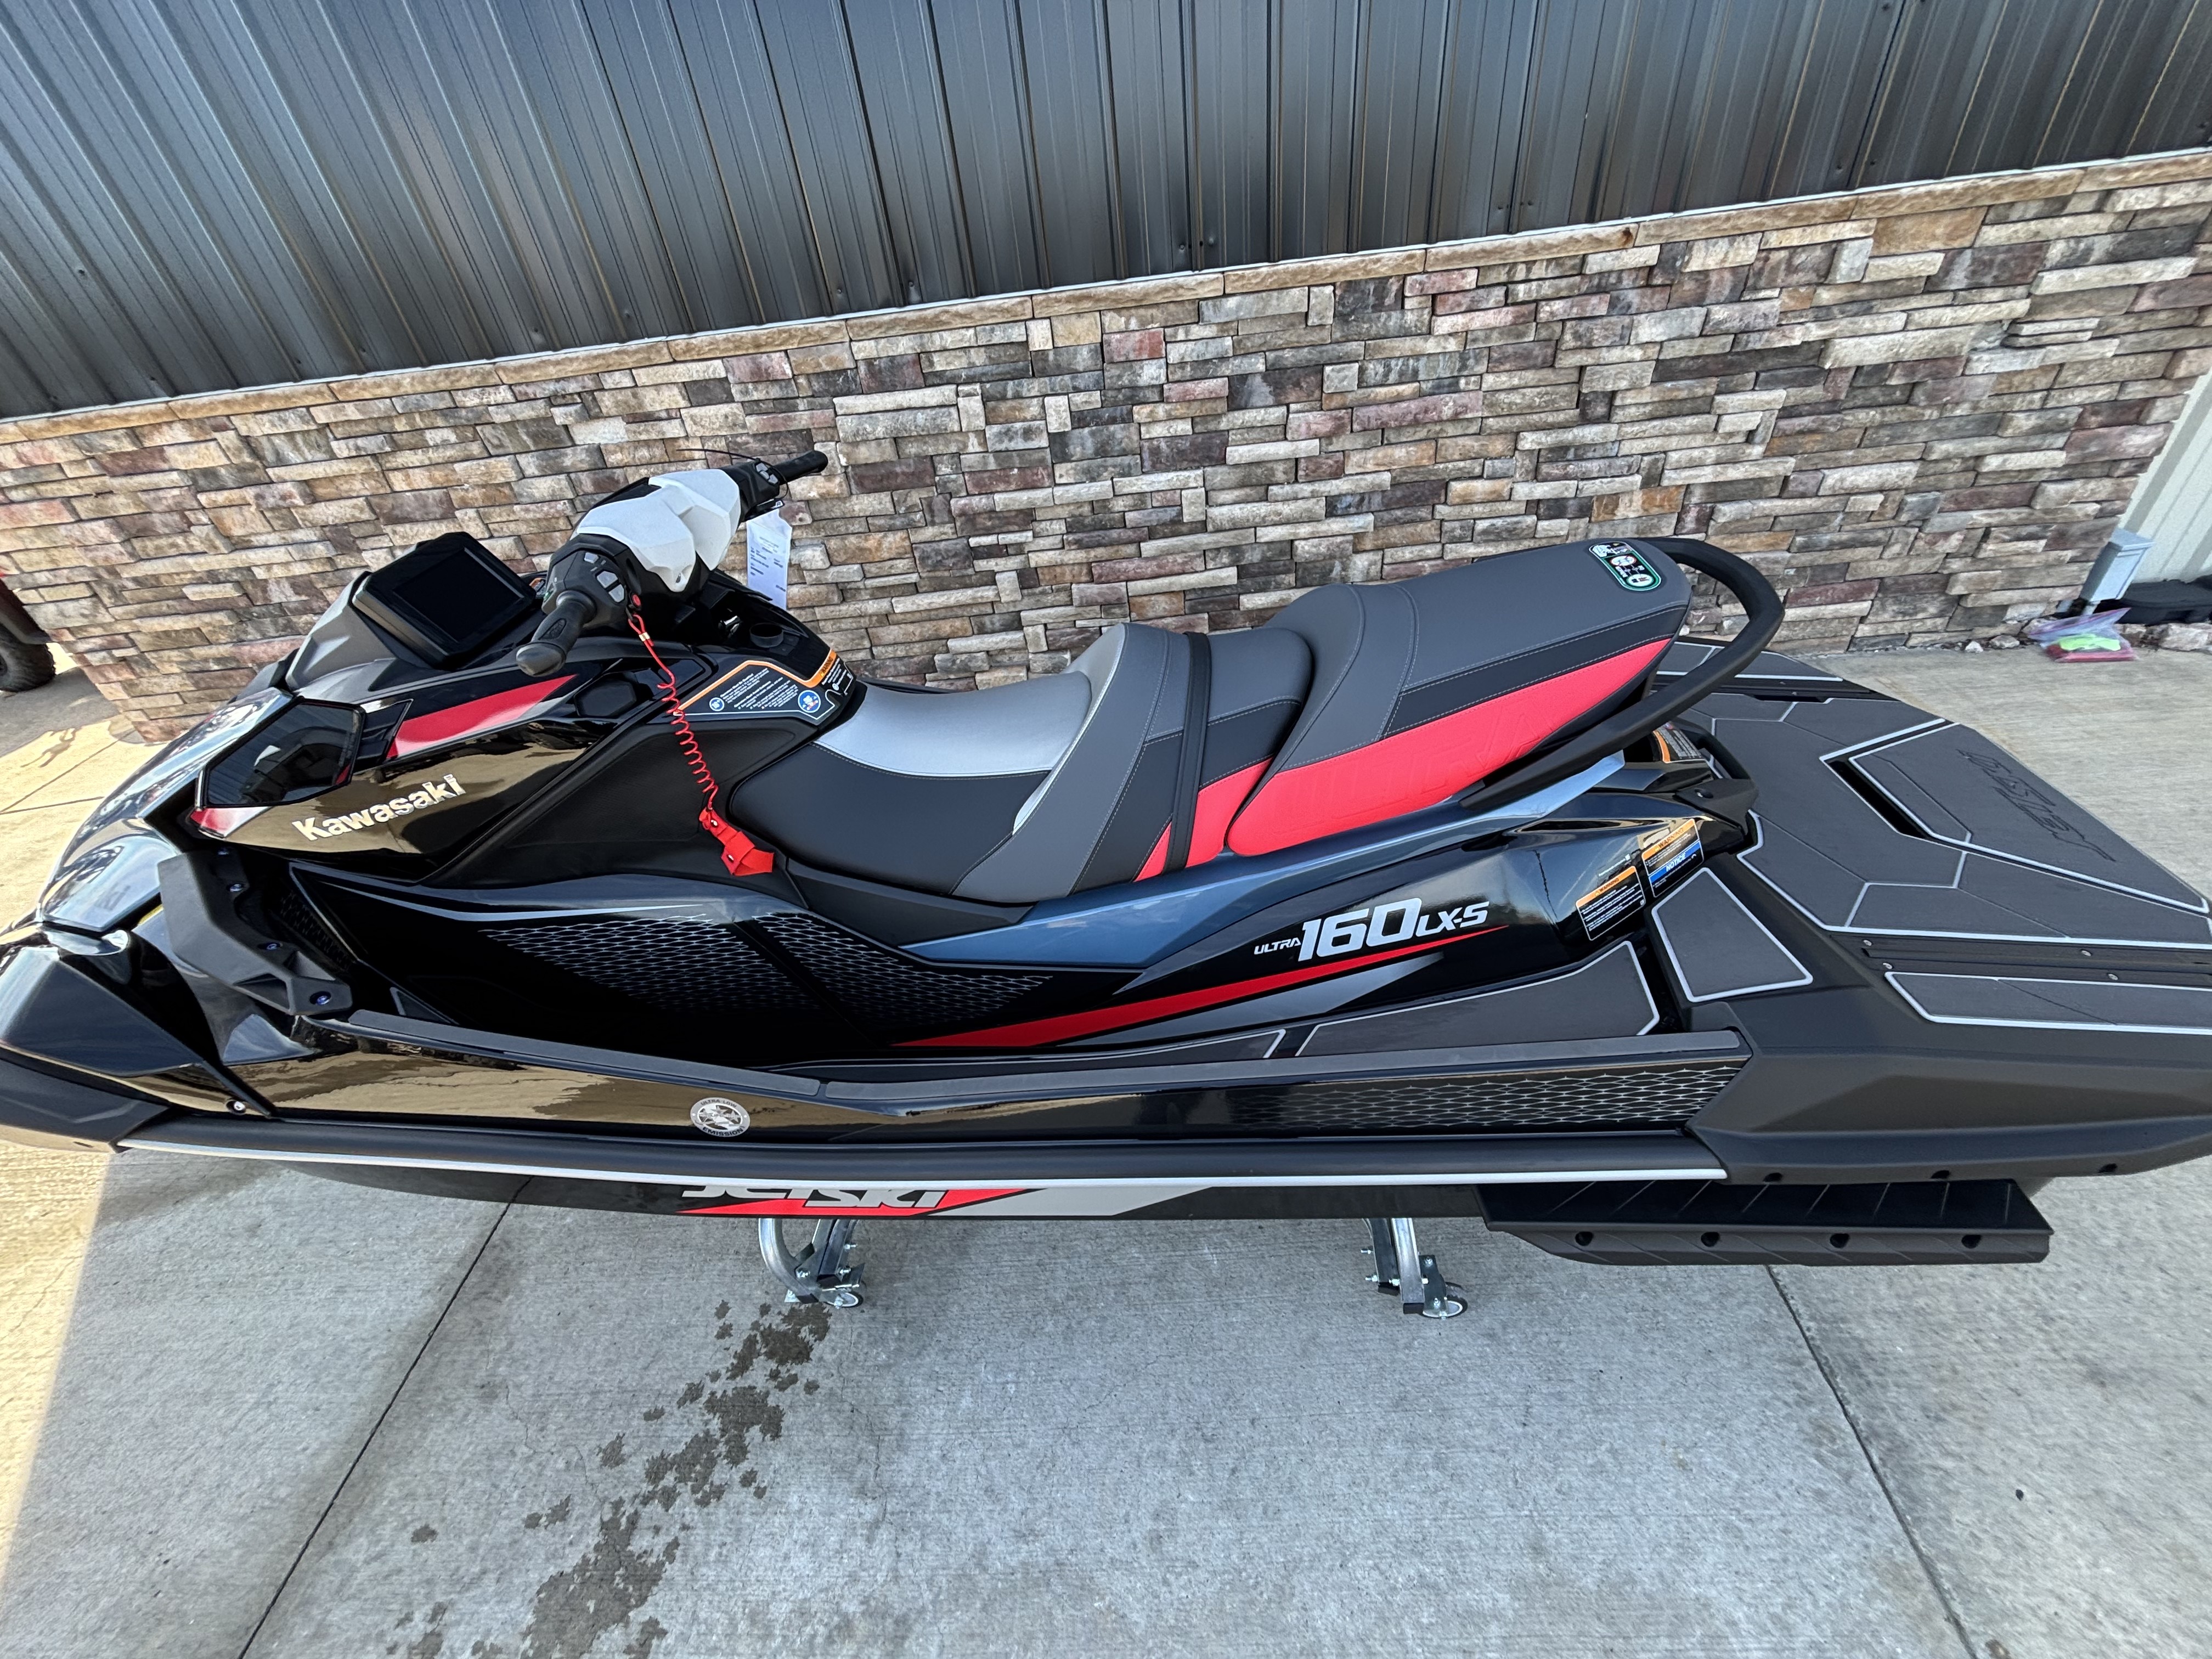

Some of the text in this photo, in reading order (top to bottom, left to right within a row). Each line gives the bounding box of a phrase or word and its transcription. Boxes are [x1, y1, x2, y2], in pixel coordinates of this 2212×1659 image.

[292, 774, 466, 840] Kawasaki
[1658, 828, 1684, 848] WARNING
[1666, 852, 1686, 872] NOTICE
[1599, 878, 1619, 893] WARNING
[1254, 898, 1489, 961] ULTRA 160 LX-S
[703, 1126, 743, 1136] EMISSION
